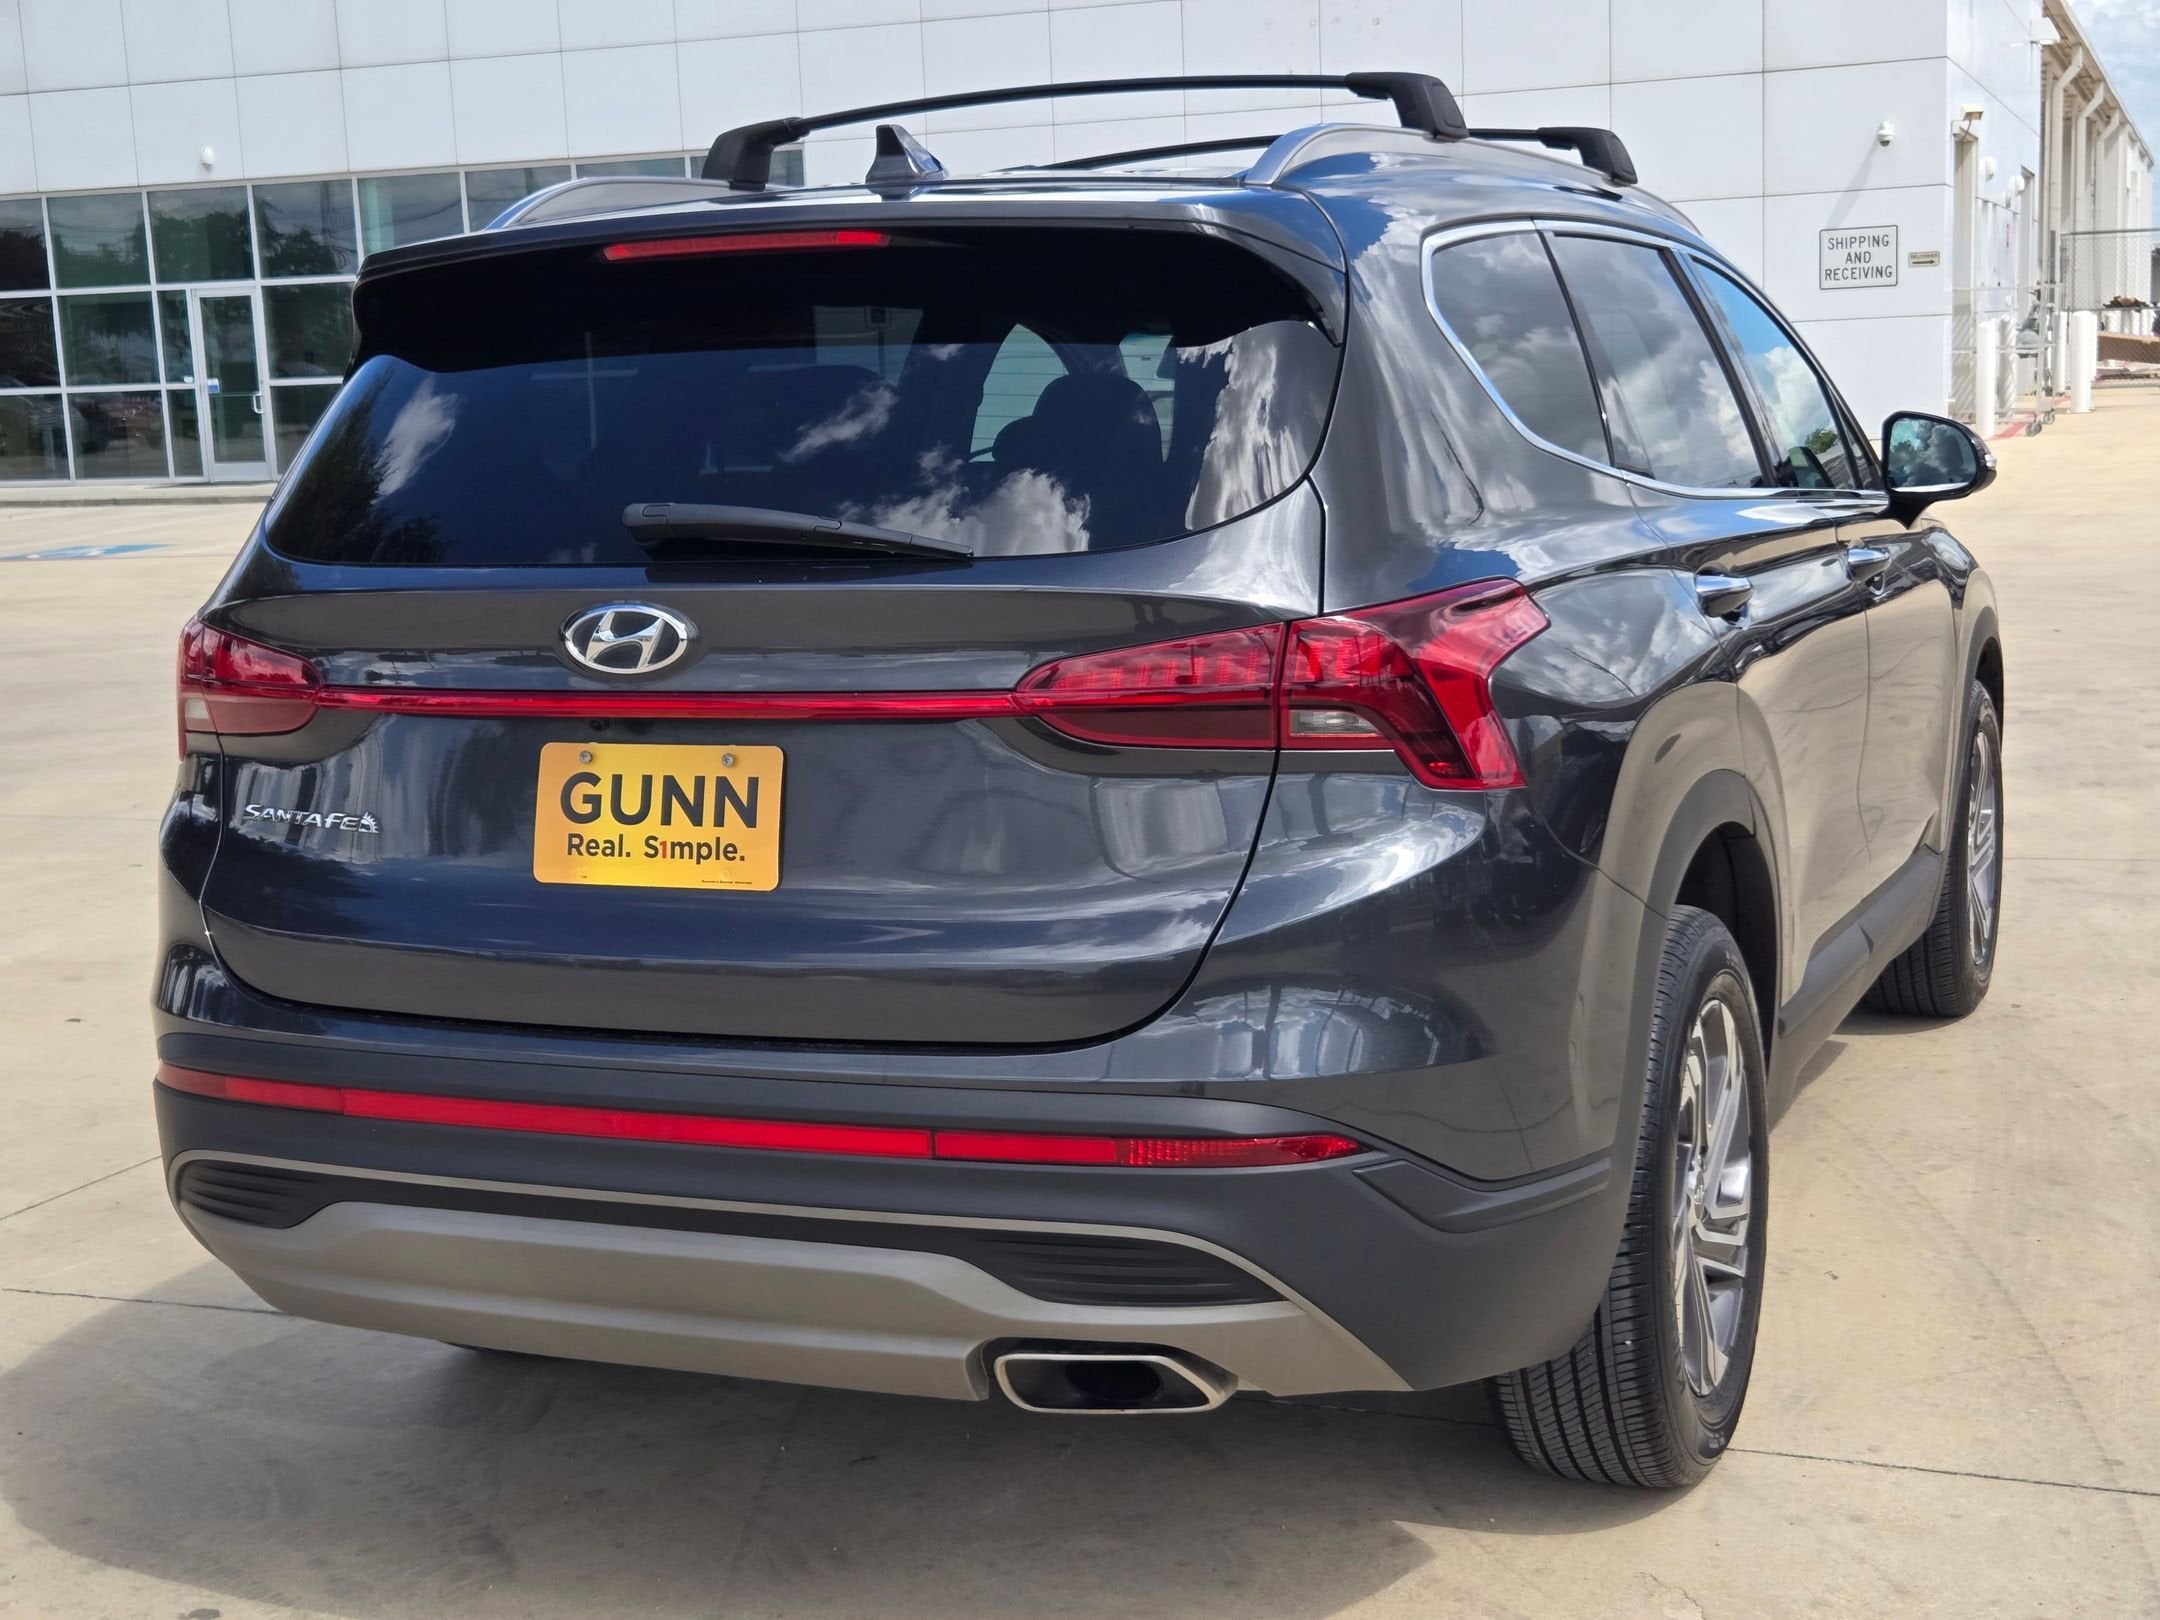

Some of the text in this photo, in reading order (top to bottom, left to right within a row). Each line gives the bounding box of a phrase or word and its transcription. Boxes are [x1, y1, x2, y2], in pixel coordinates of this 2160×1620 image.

[1827, 234, 1890, 250] SHIPPING
[1845, 251, 1872, 265] AND
[1824, 265, 1893, 280] RECEIVING
[560, 771, 760, 829] GUNN
[567, 833, 631, 858] Real.
